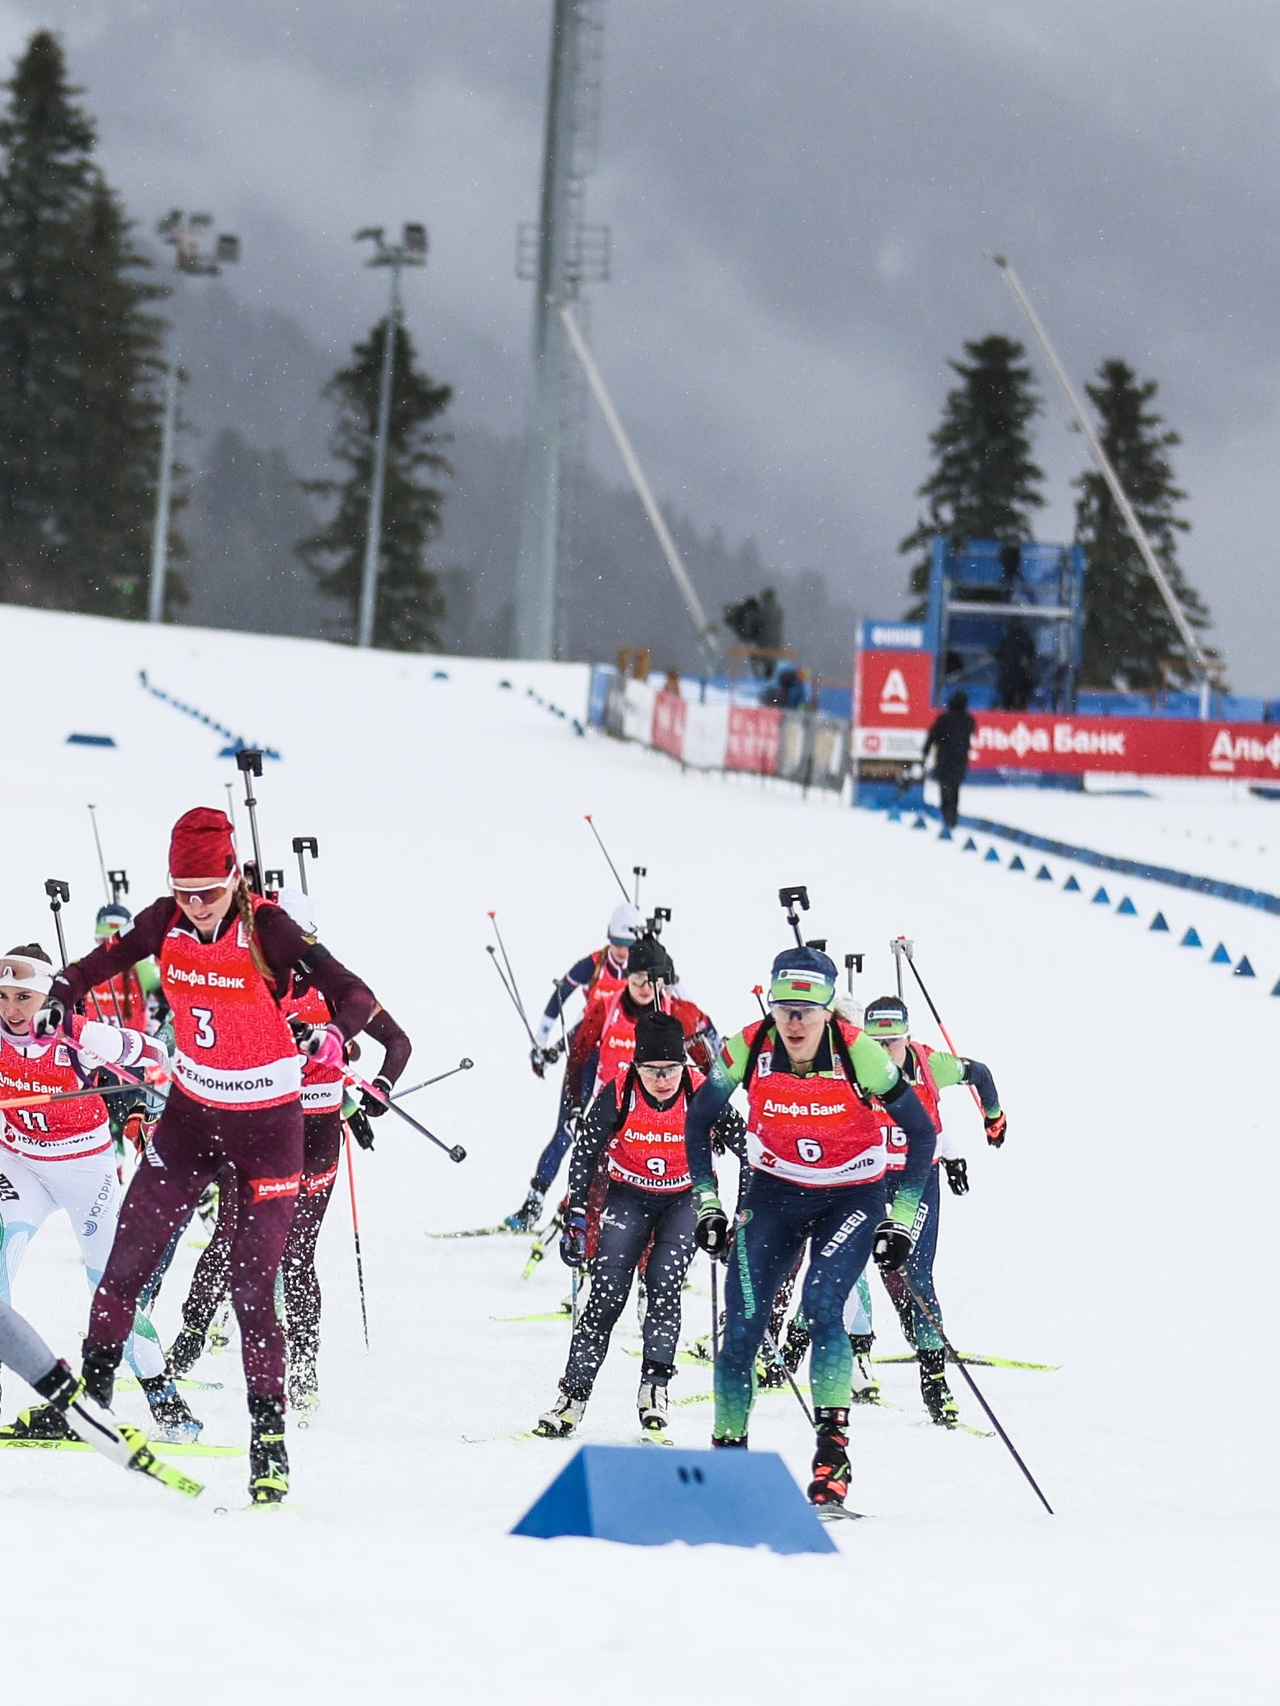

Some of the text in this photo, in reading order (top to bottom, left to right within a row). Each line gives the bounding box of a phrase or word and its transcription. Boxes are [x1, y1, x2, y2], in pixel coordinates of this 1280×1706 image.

[1053, 723, 1125, 755] Банк
[167, 964, 245, 989] Альфа Банк
[191, 1007, 216, 1049] 3
[32, 1082, 63, 1094] Банк
[763, 1099, 847, 1118] Альфа Банк
[17, 1109, 50, 1132] 11
[624, 1128, 662, 1143] Альфа
[880, 1125, 907, 1147] 15
[797, 1138, 822, 1163] 6
[646, 1157, 667, 1177] 9
